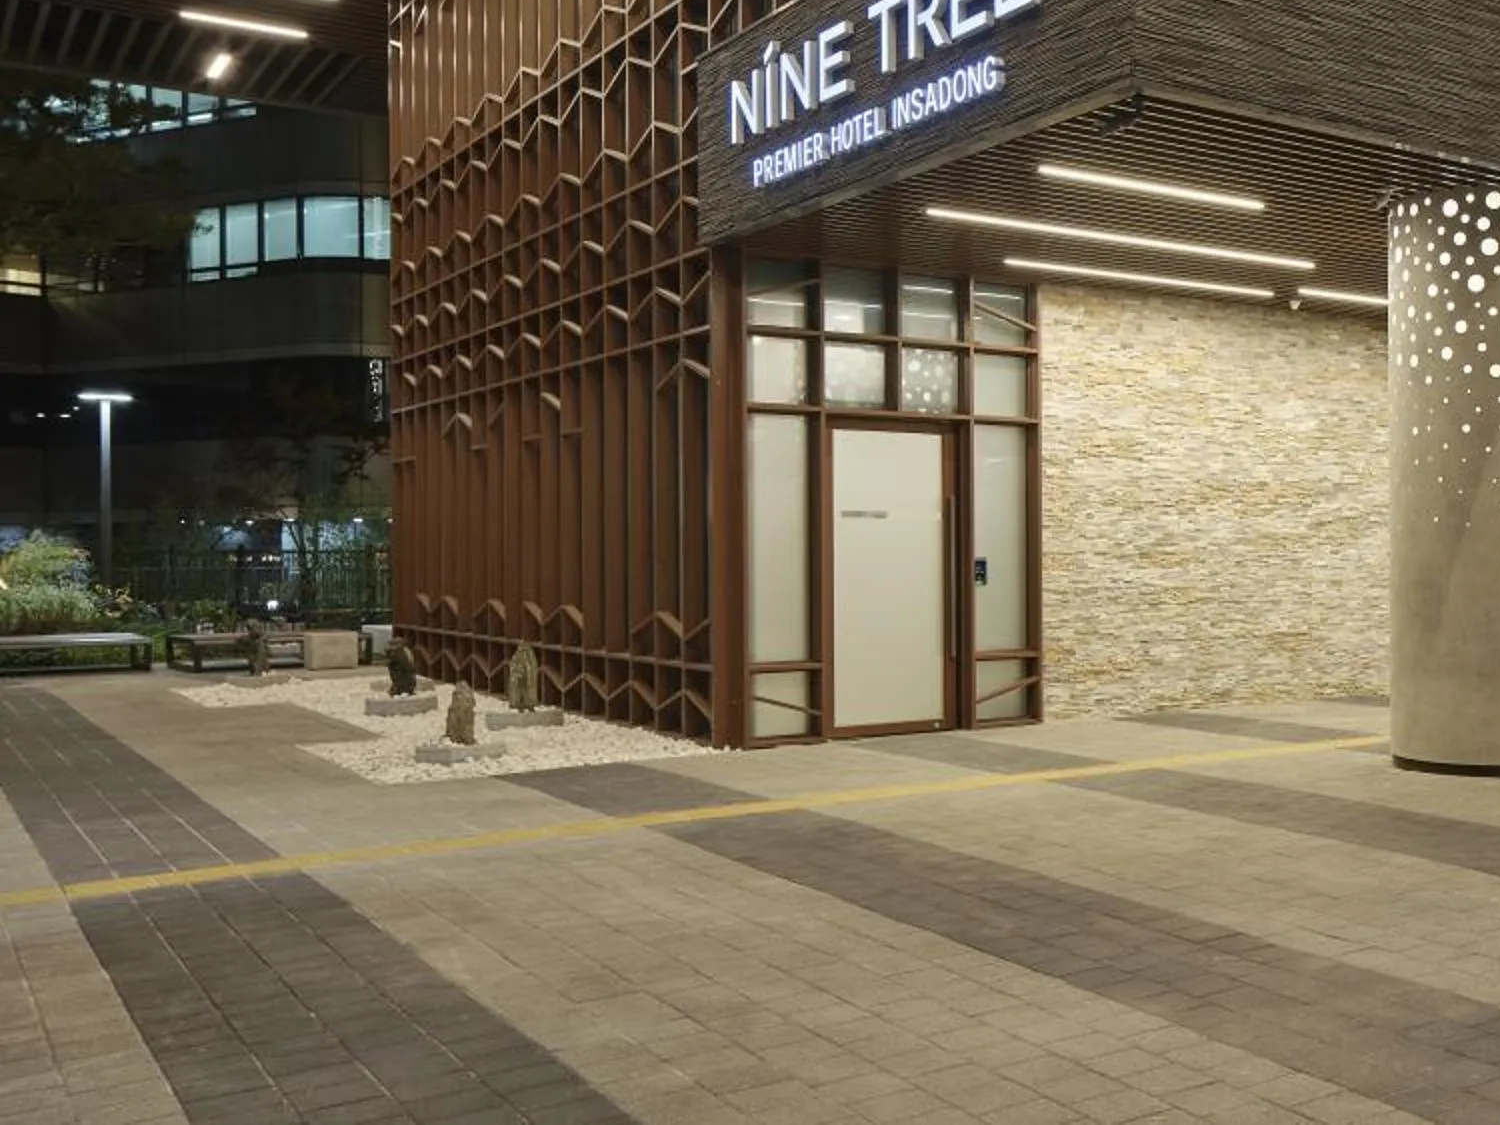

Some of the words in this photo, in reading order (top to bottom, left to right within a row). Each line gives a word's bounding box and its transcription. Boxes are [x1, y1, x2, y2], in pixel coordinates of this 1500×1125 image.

[752, 133, 829, 188] PREMIER
[831, 106, 887, 156] HOTEL
[891, 55, 1005, 129] INSADONG
